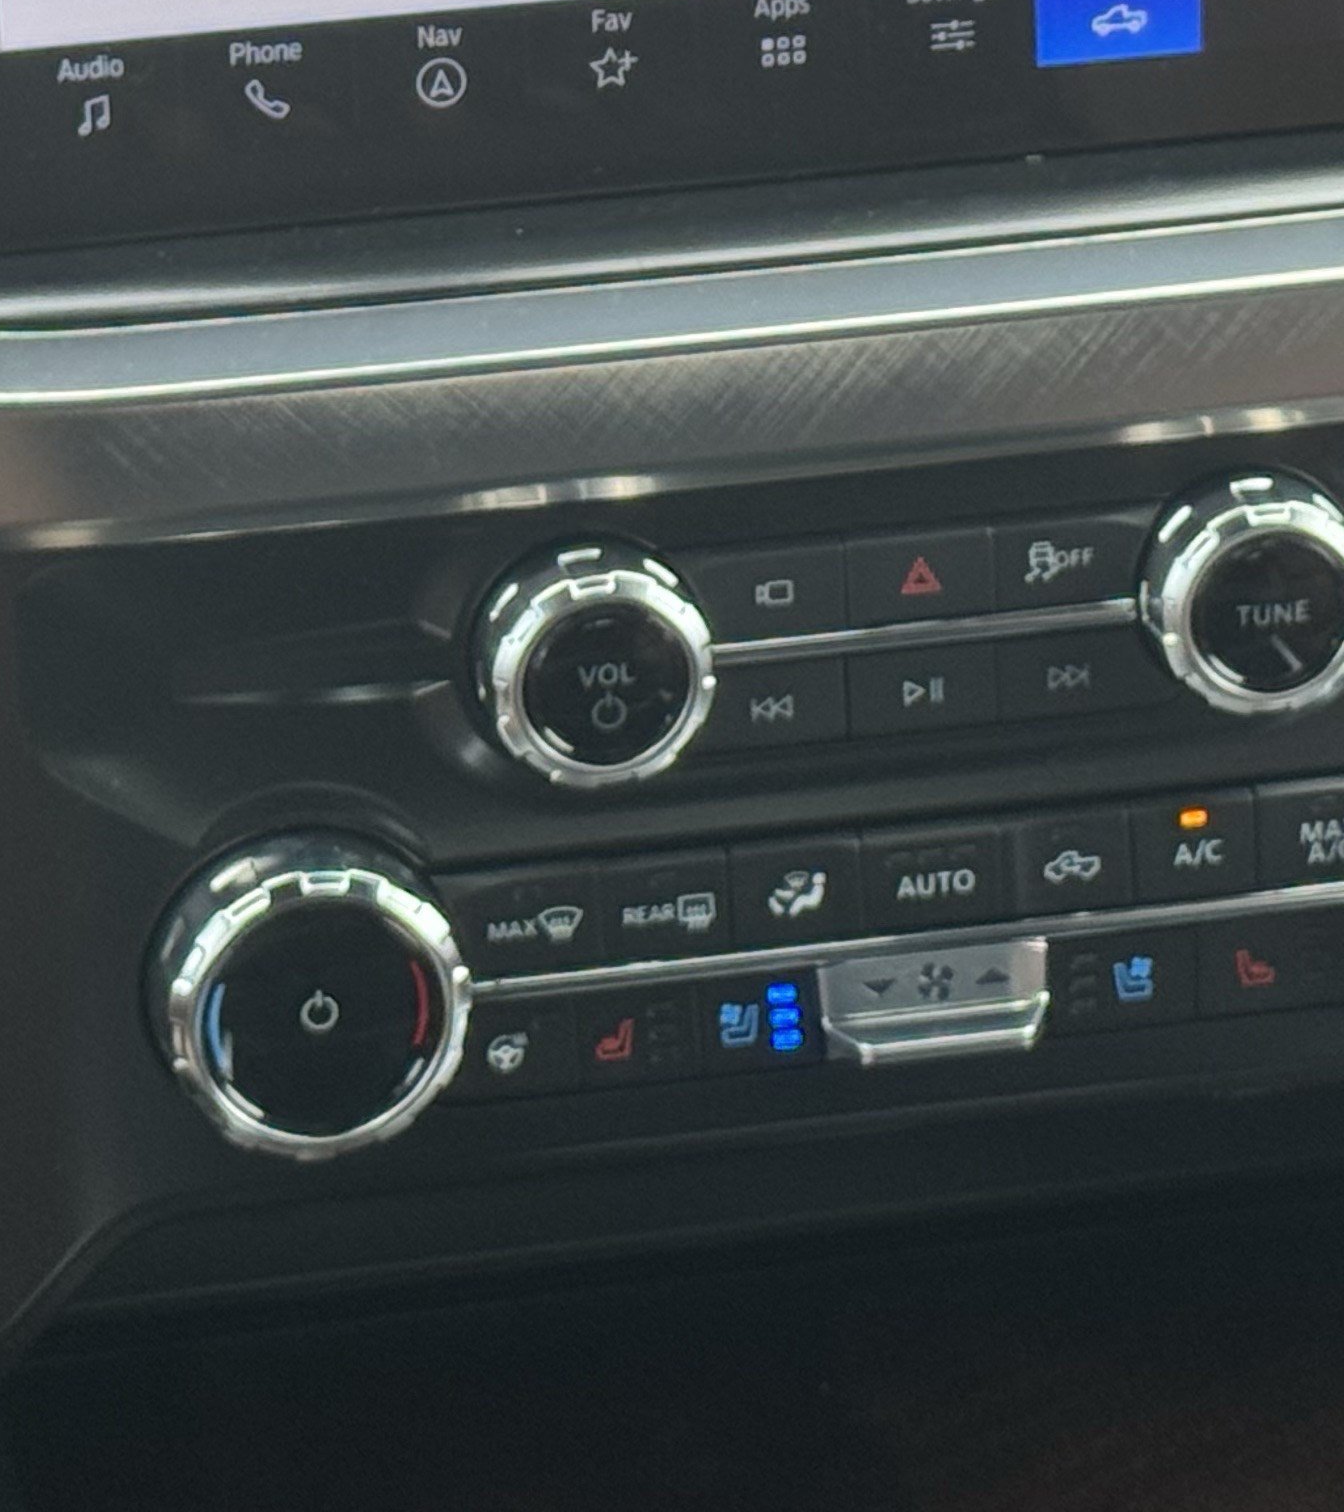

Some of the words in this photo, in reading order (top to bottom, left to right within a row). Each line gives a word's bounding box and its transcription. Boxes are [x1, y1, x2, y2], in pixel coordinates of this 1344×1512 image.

[591, 8, 633, 34] Fav
[417, 24, 463, 49] Nav
[229, 38, 303, 66] Phone
[57, 55, 125, 84] Audio
[1056, 546, 1095, 569] OFF
[1235, 598, 1311, 629] TUNE
[577, 662, 636, 689] VOL
[1172, 837, 1226, 868] A/C
[896, 868, 977, 901] AUTO
[621, 903, 676, 929] REAR
[486, 919, 539, 943] MAX
